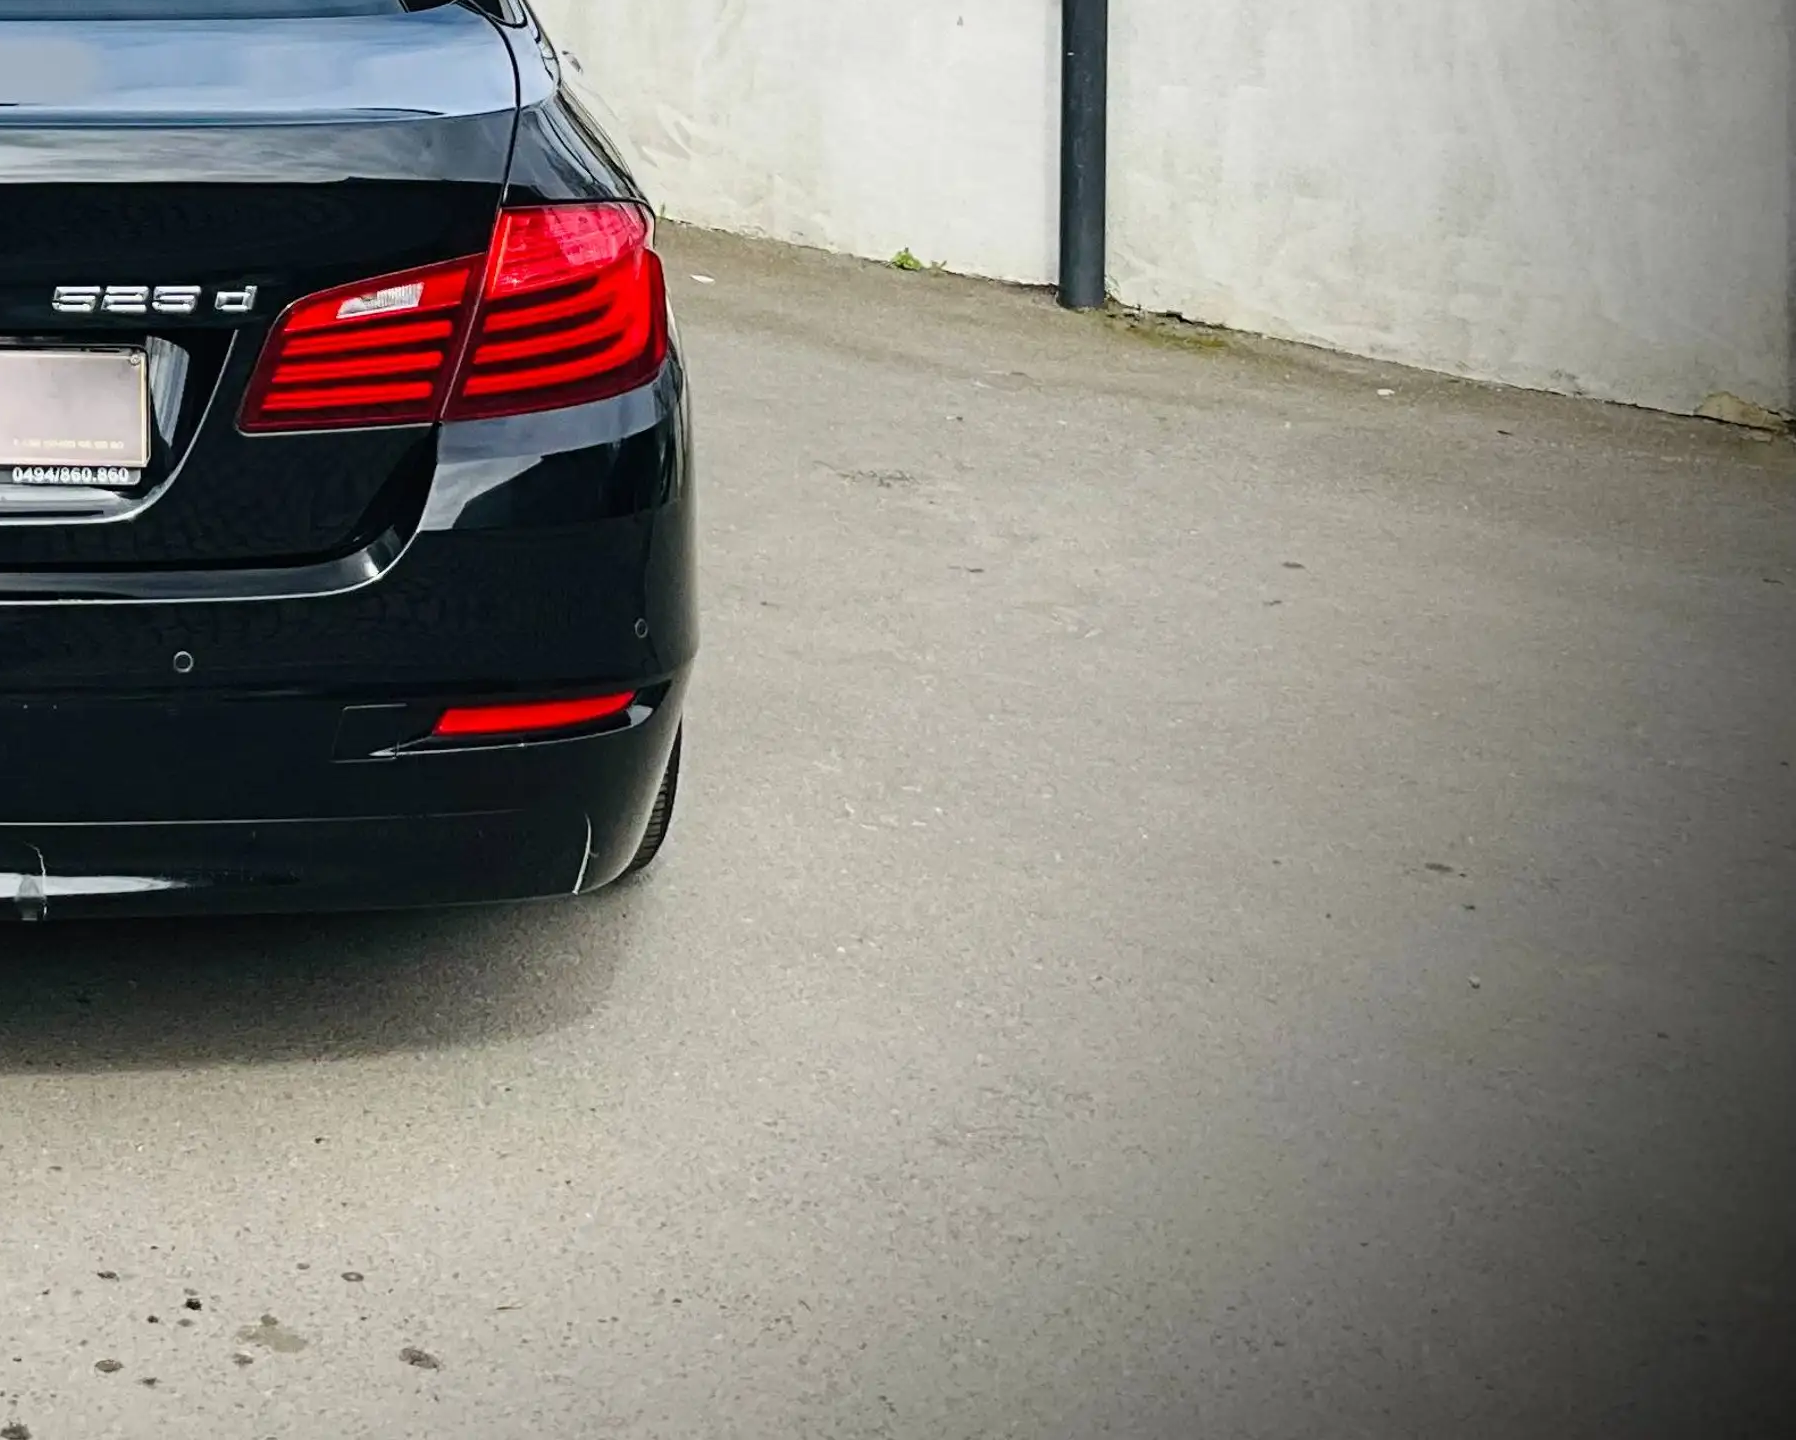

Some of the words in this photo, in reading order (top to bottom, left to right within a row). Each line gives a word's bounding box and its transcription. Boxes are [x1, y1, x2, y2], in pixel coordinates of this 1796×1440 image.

[52, 285, 202, 313] 525
[214, 285, 258, 311] d
[12, 466, 129, 483] 0494/860.860
